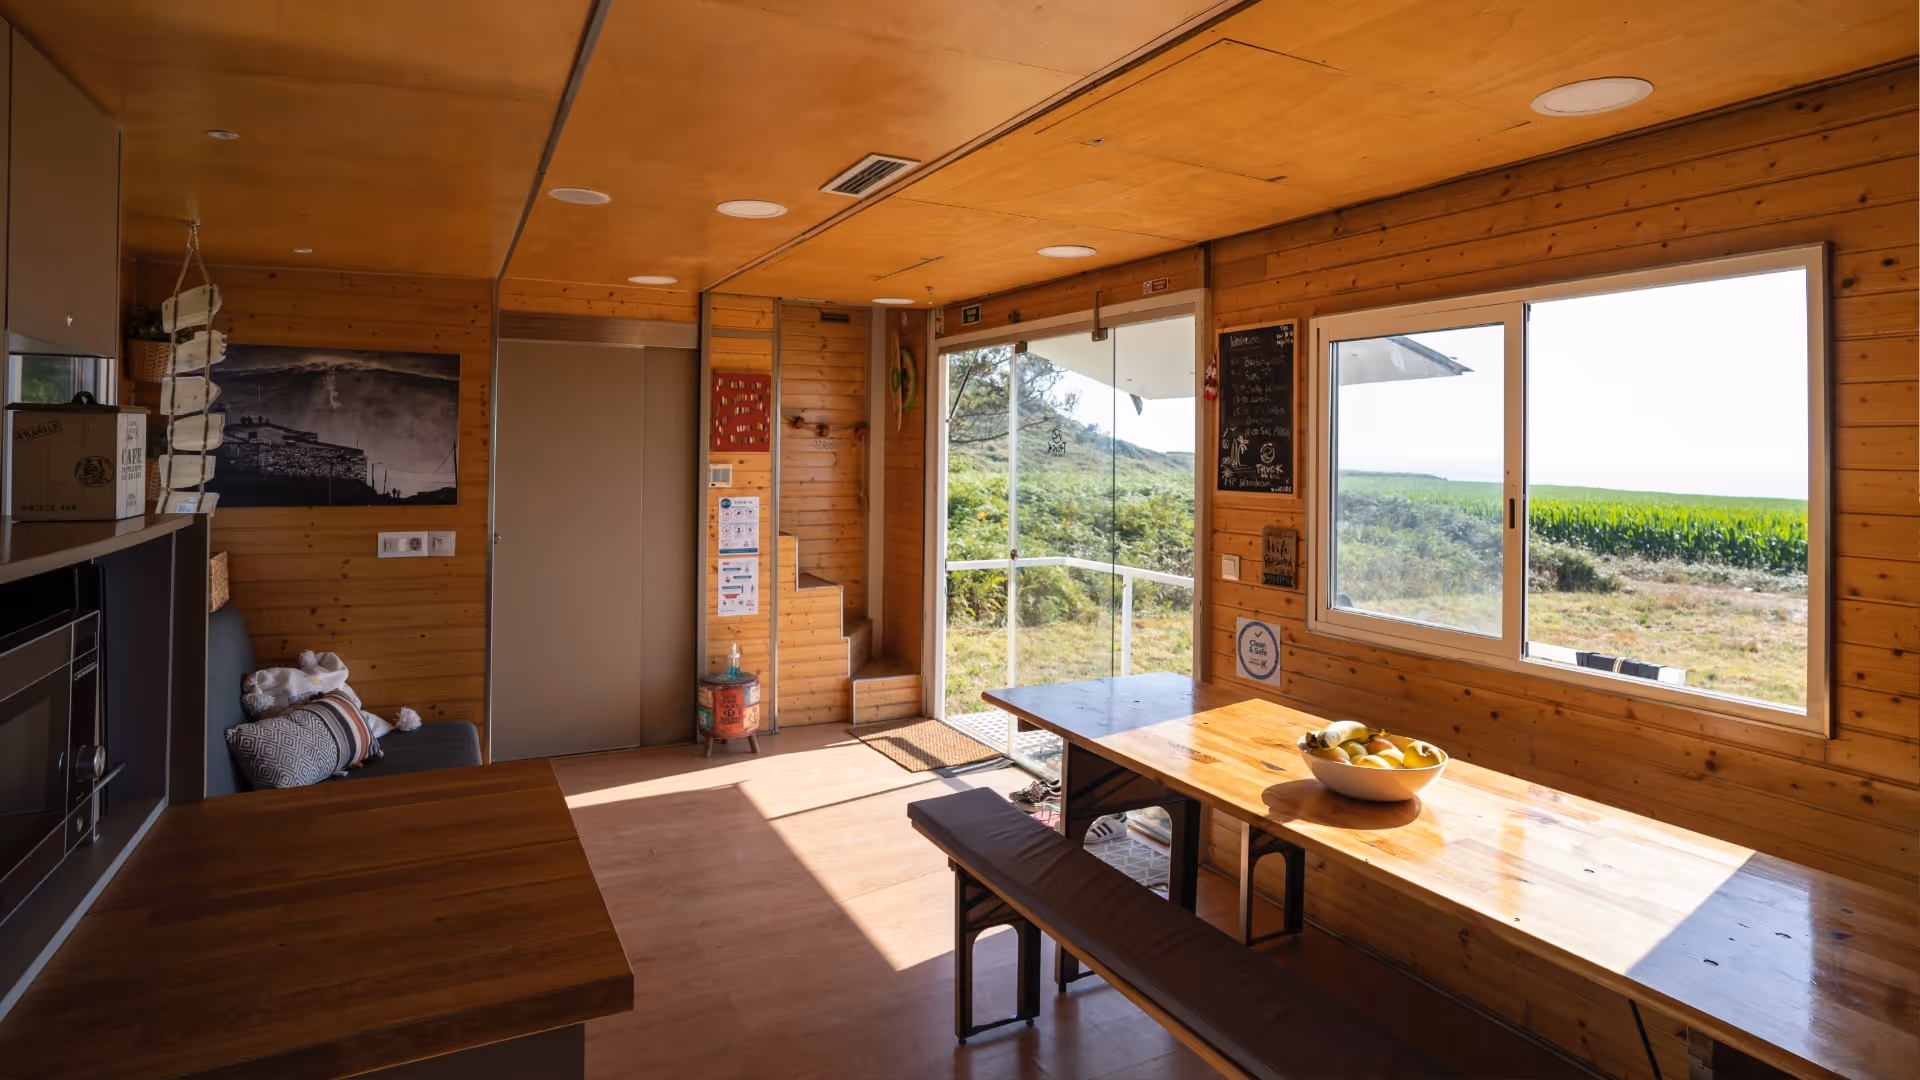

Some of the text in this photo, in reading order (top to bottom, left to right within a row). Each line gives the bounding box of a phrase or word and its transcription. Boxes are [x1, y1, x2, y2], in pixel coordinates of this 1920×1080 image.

[16, 421, 60, 441] FRAGILE
[1249, 639, 1267, 649] Clean
[1254, 648, 1268, 656] Safe
